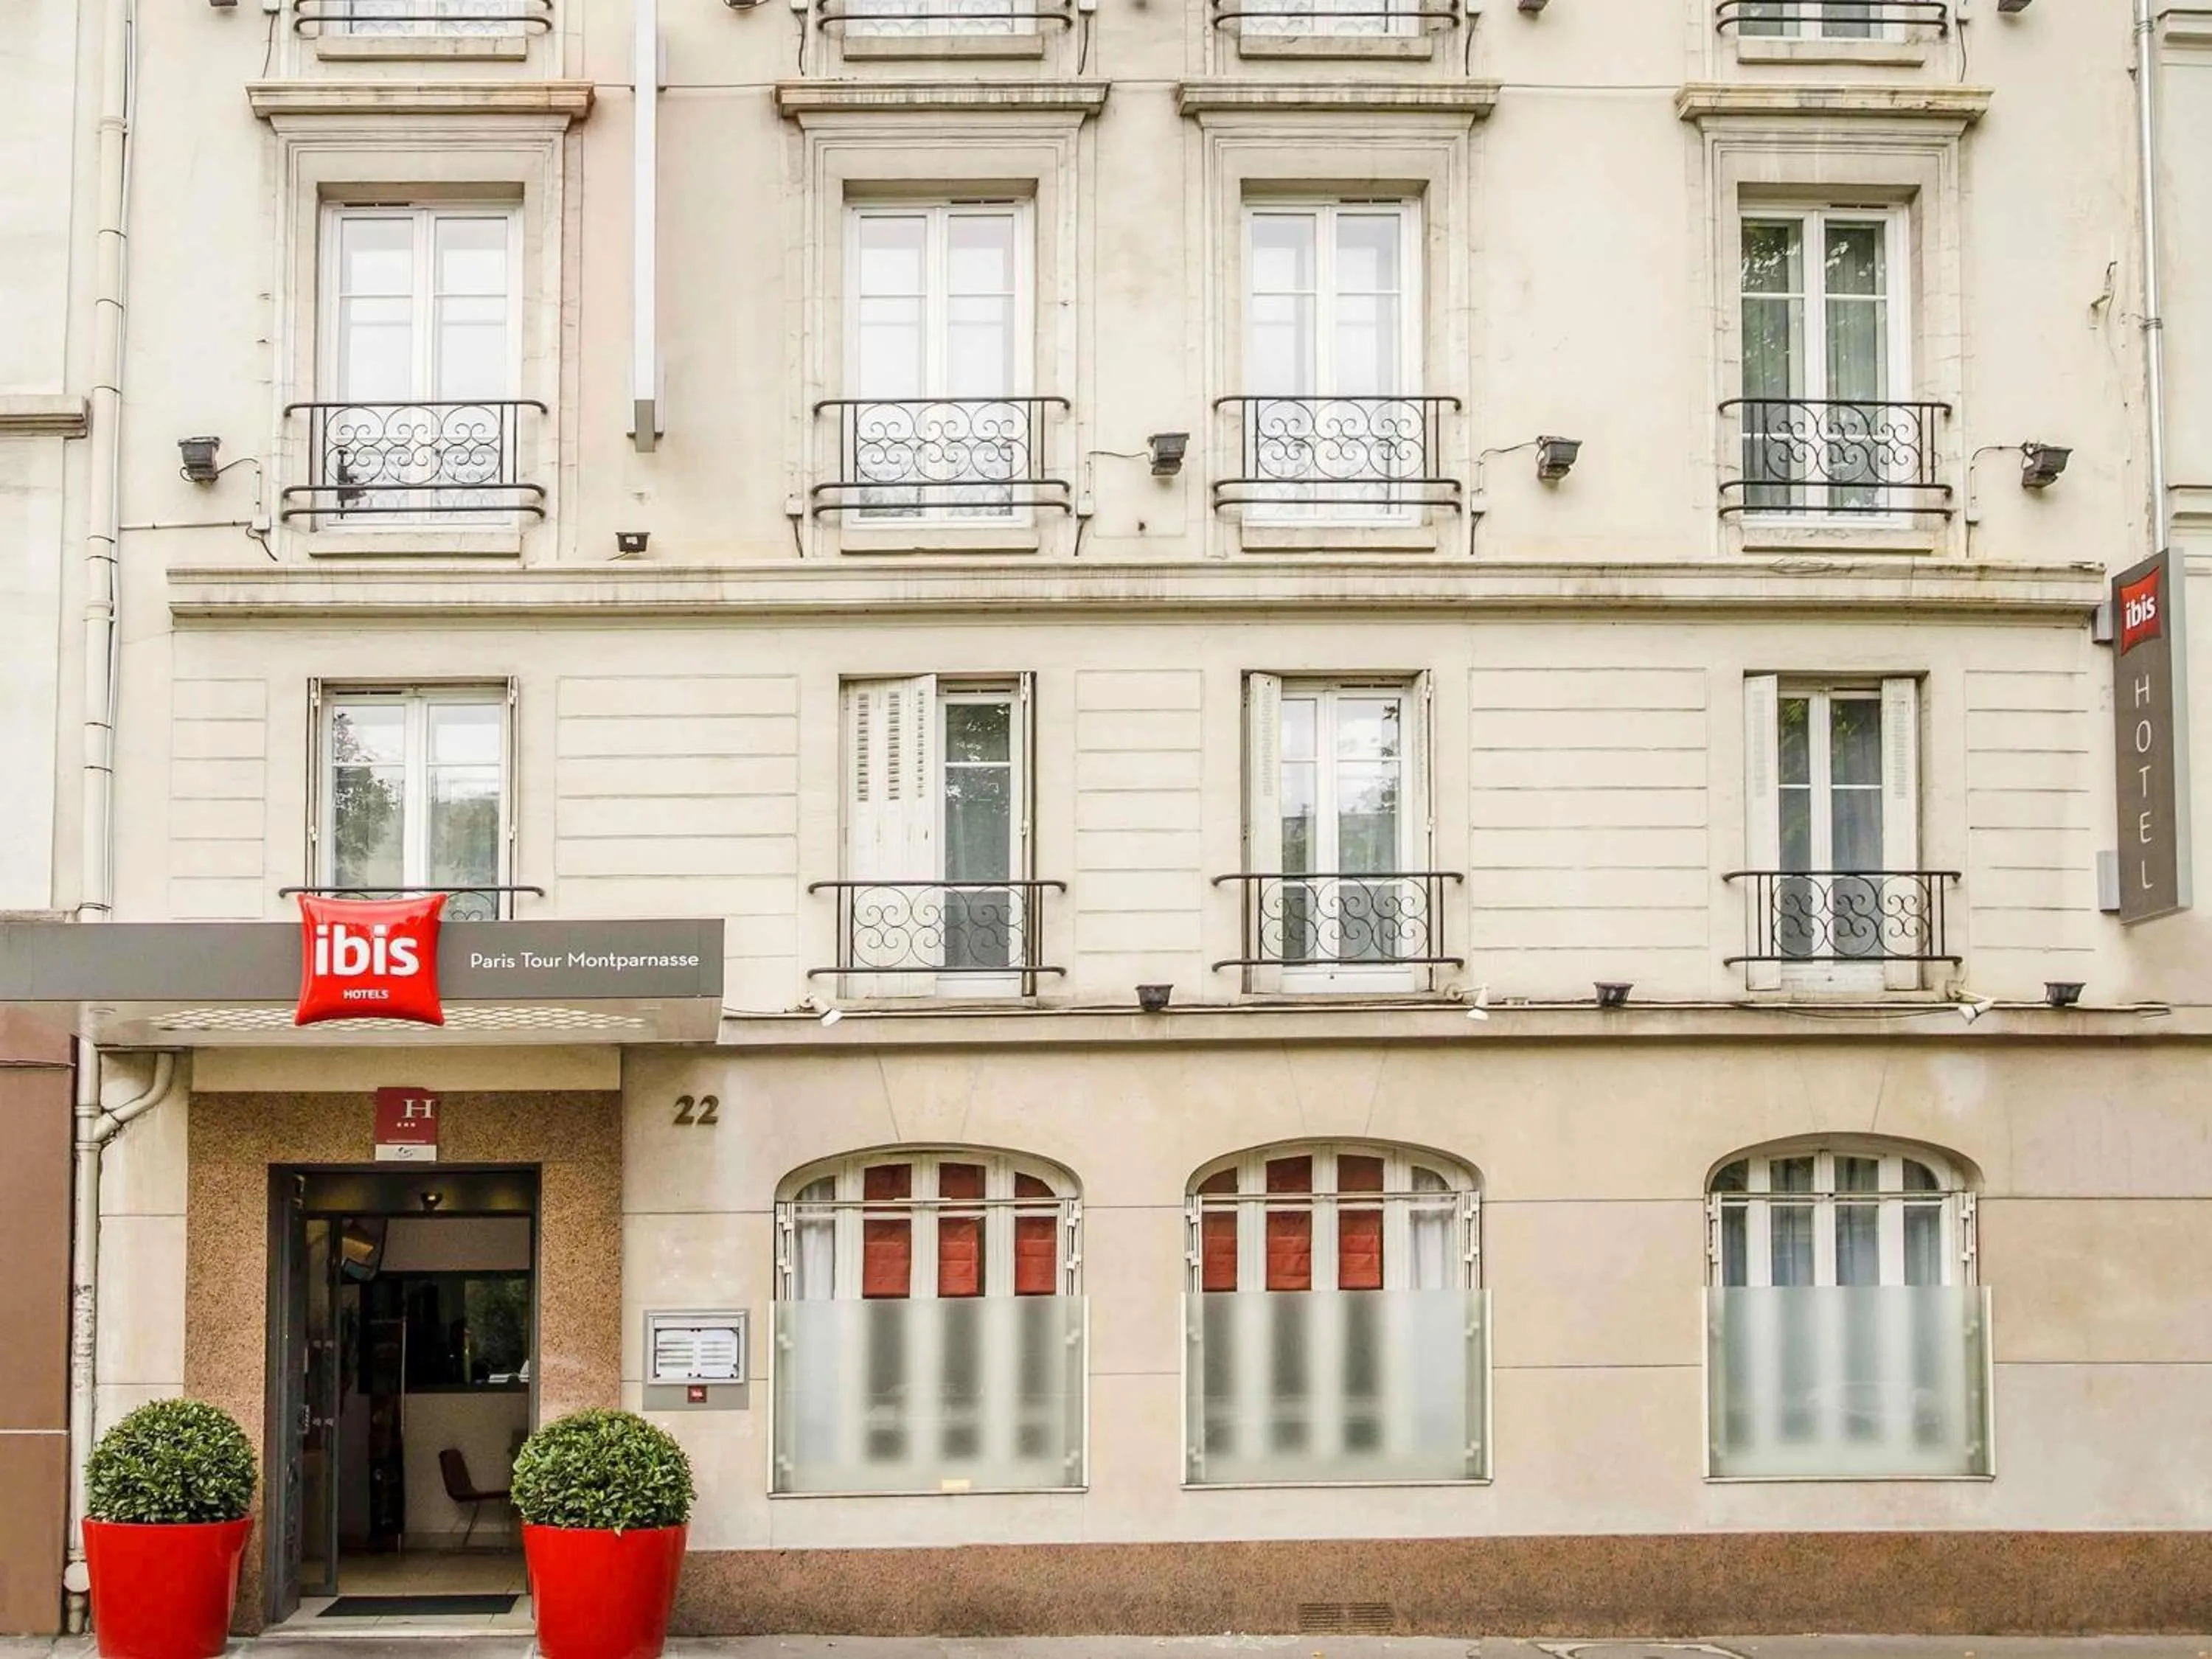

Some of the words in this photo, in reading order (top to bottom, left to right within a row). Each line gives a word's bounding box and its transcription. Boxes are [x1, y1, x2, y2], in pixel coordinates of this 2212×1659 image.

[2126, 594, 2155, 630] ibis
[2135, 675, 2154, 889] HOTEL
[316, 924, 420, 976] ibis
[470, 952, 515, 969] Paris
[521, 952, 563, 969] Tour
[568, 952, 699, 972] Montparnasse
[344, 990, 389, 1000] HOTELS
[401, 1099, 435, 1119] H
[672, 1095, 720, 1126] 22
